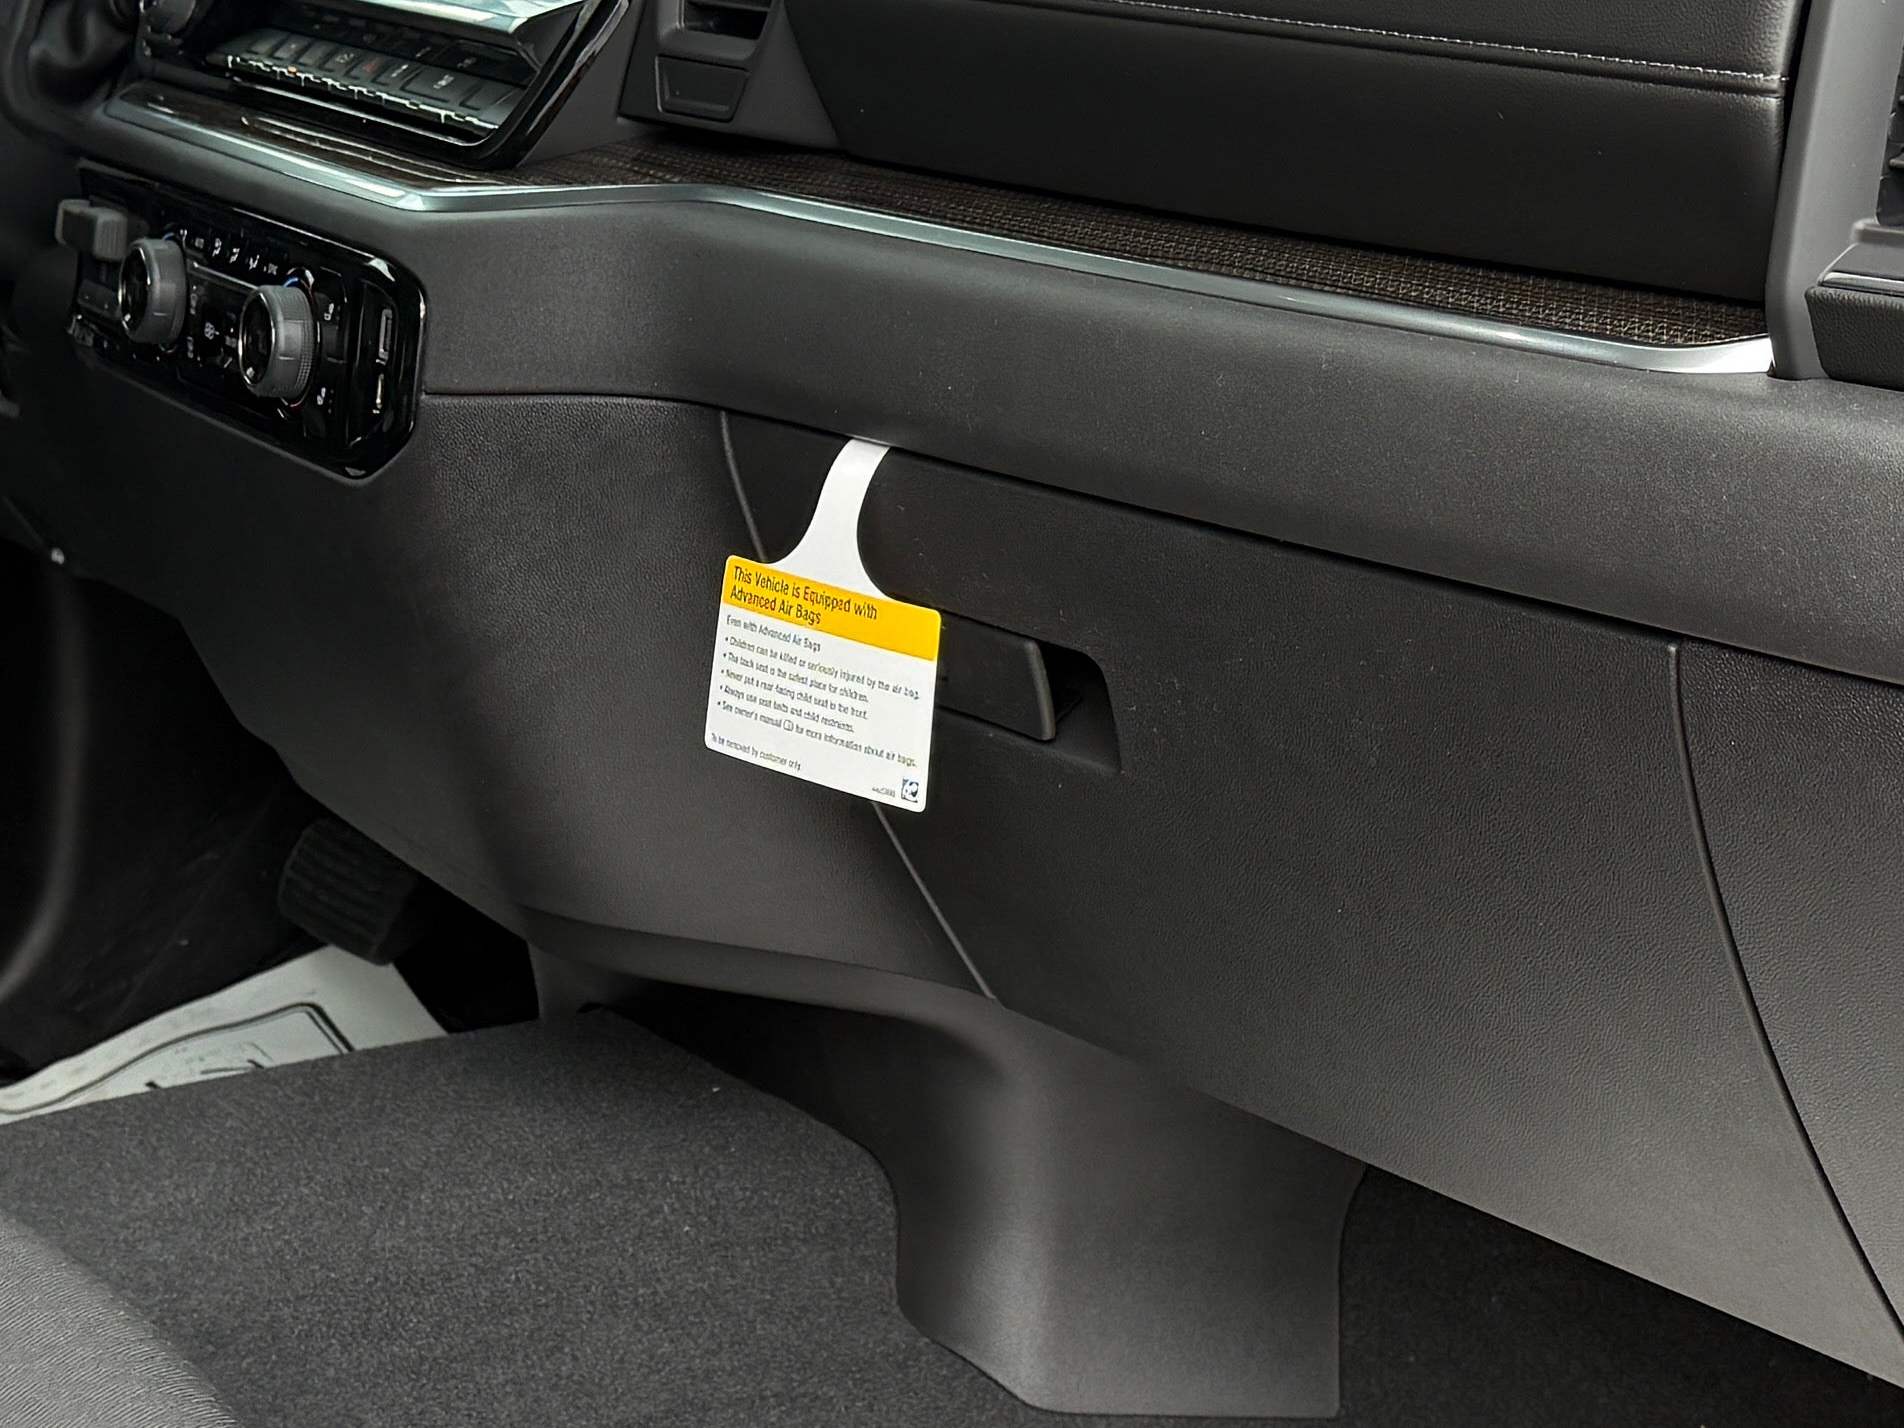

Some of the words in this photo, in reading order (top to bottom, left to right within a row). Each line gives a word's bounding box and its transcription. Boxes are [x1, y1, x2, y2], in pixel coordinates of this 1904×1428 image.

[730, 585, 777, 611] Advanced
[778, 598, 794, 616] Air
[796, 603, 822, 626] Bags
[733, 565, 752, 585] This
[755, 571, 789, 595] Vehicle
[792, 583, 800, 599] is
[803, 586, 851, 613] Equipped
[854, 599, 878, 620] with
